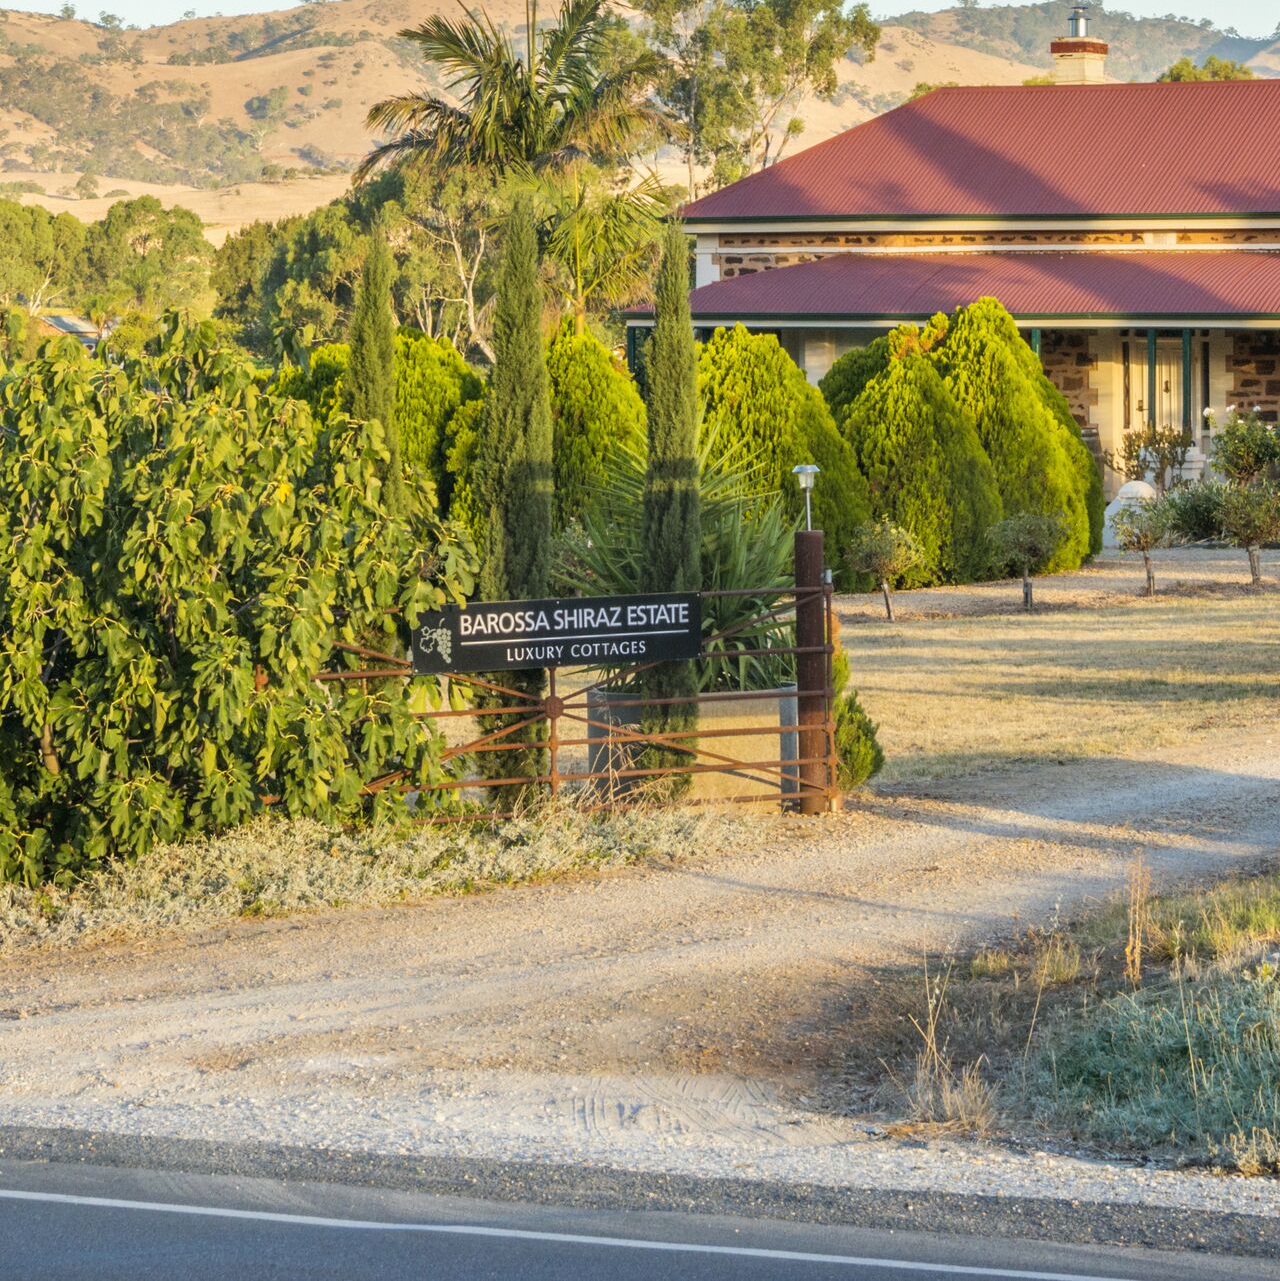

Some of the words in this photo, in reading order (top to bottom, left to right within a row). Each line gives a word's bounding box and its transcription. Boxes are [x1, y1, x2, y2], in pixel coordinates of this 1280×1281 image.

[460, 610, 550, 636] BAROSSA
[553, 606, 622, 630] SHIRAZ
[627, 603, 689, 626] ESTATE
[507, 645, 564, 661] LUXURY
[571, 641, 646, 658] COTTAGES
